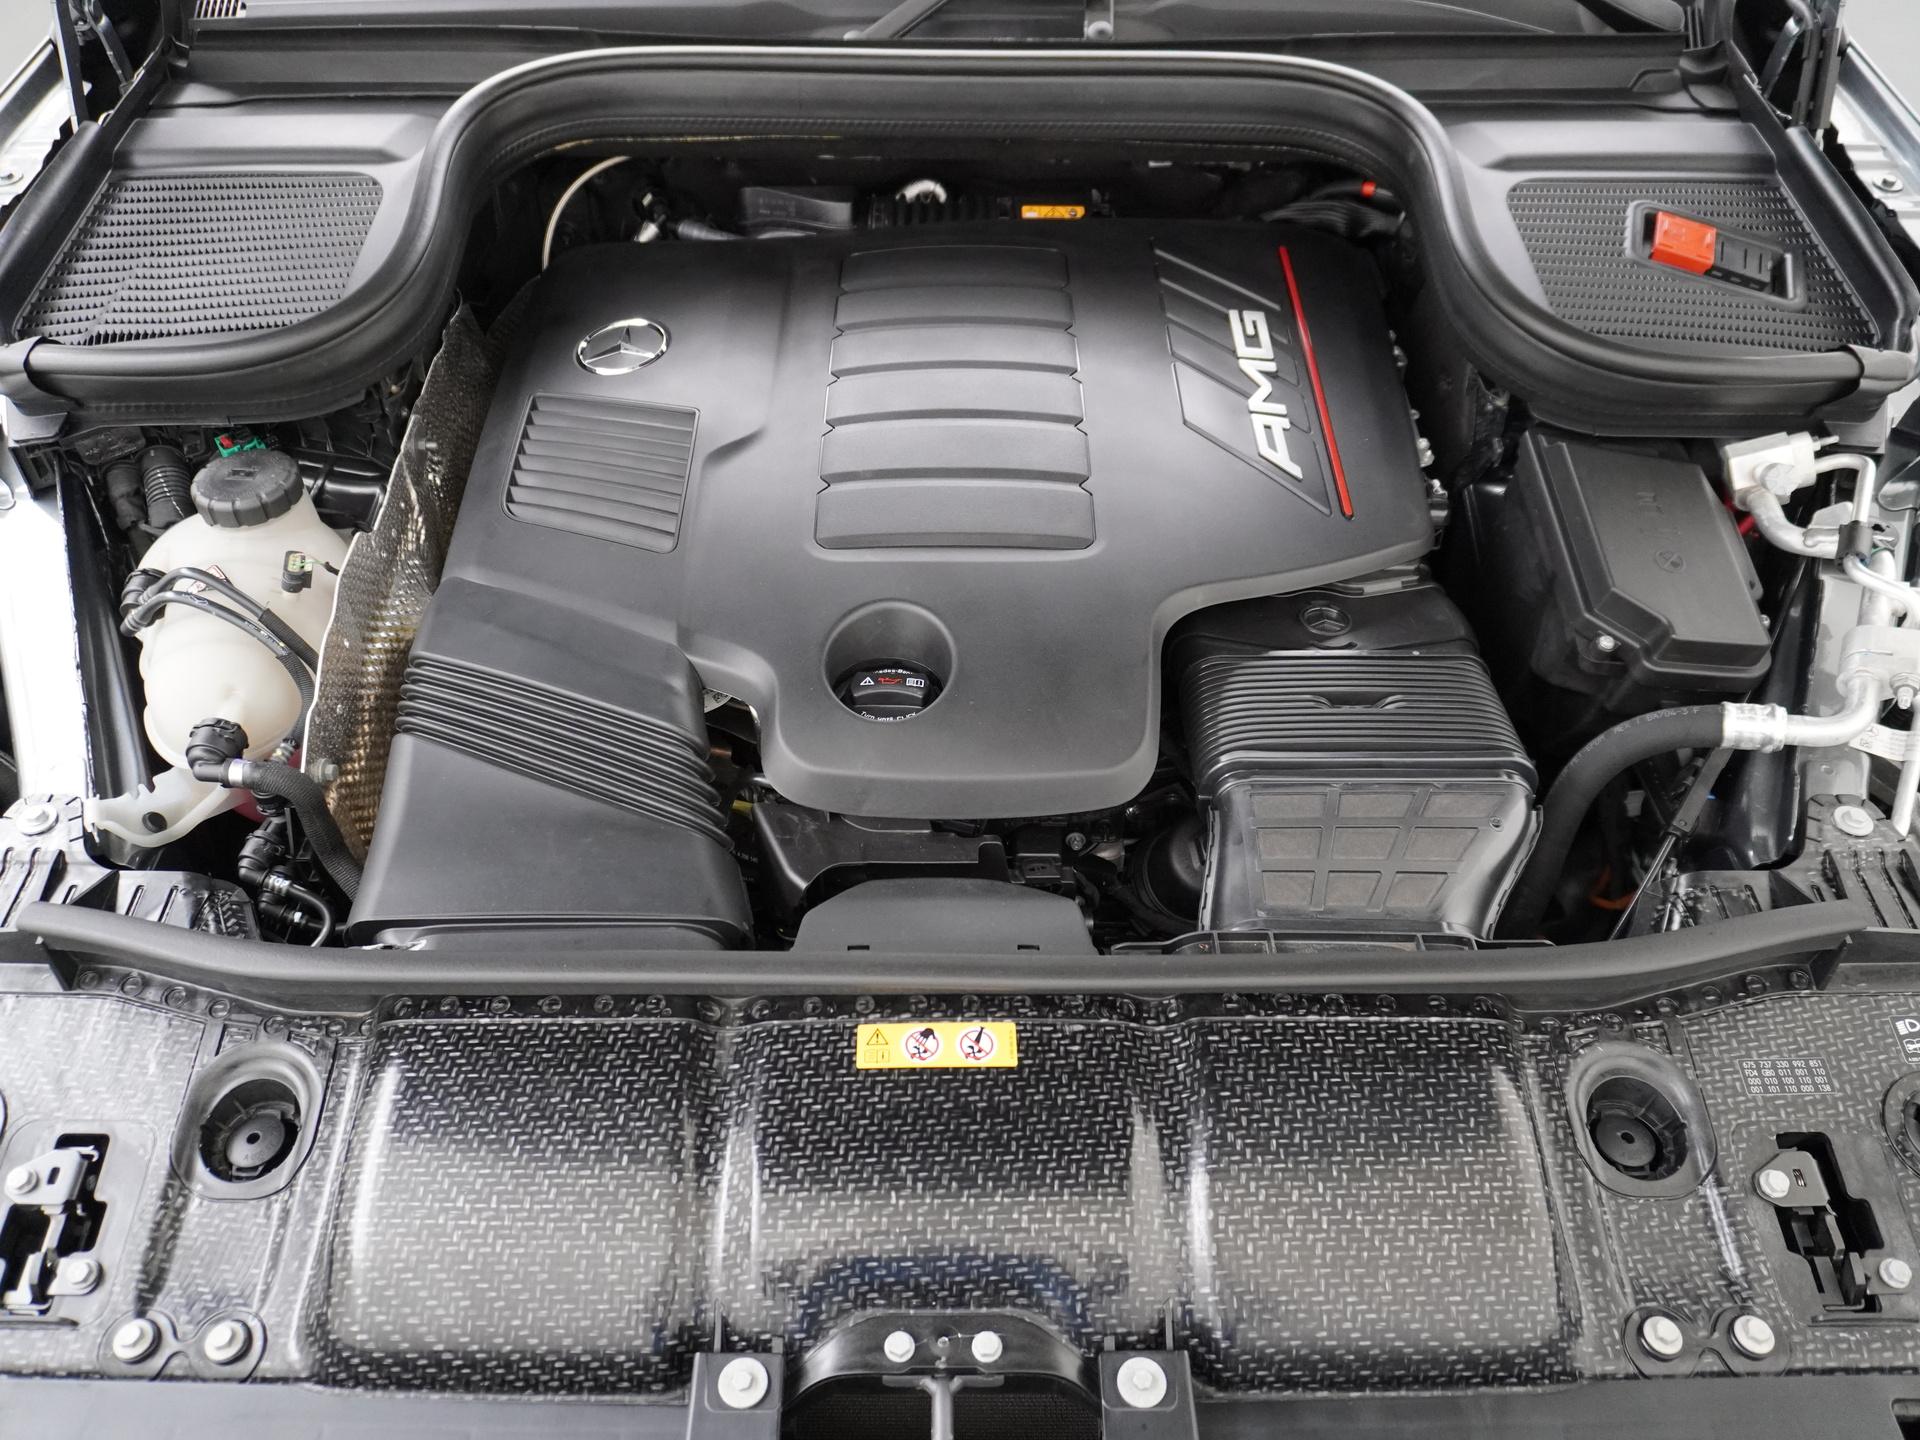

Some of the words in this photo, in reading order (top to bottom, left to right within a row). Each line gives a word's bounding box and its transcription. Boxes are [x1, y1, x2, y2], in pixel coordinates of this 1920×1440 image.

[1228, 309, 1303, 480] AMG
[1743, 1061, 1756, 1069] 675
[1759, 1060, 1772, 1068] 737
[1775, 1060, 1790, 1068] 330
[1792, 1060, 1806, 1068] 992
[1794, 1068, 1808, 1076] 001
[1747, 1077, 1762, 1085] 000
[1764, 1077, 1778, 1085] 010
[1814, 1076, 1828, 1084] 001
[1784, 1085, 1798, 1093] 110
[1818, 1084, 1832, 1092] 138
